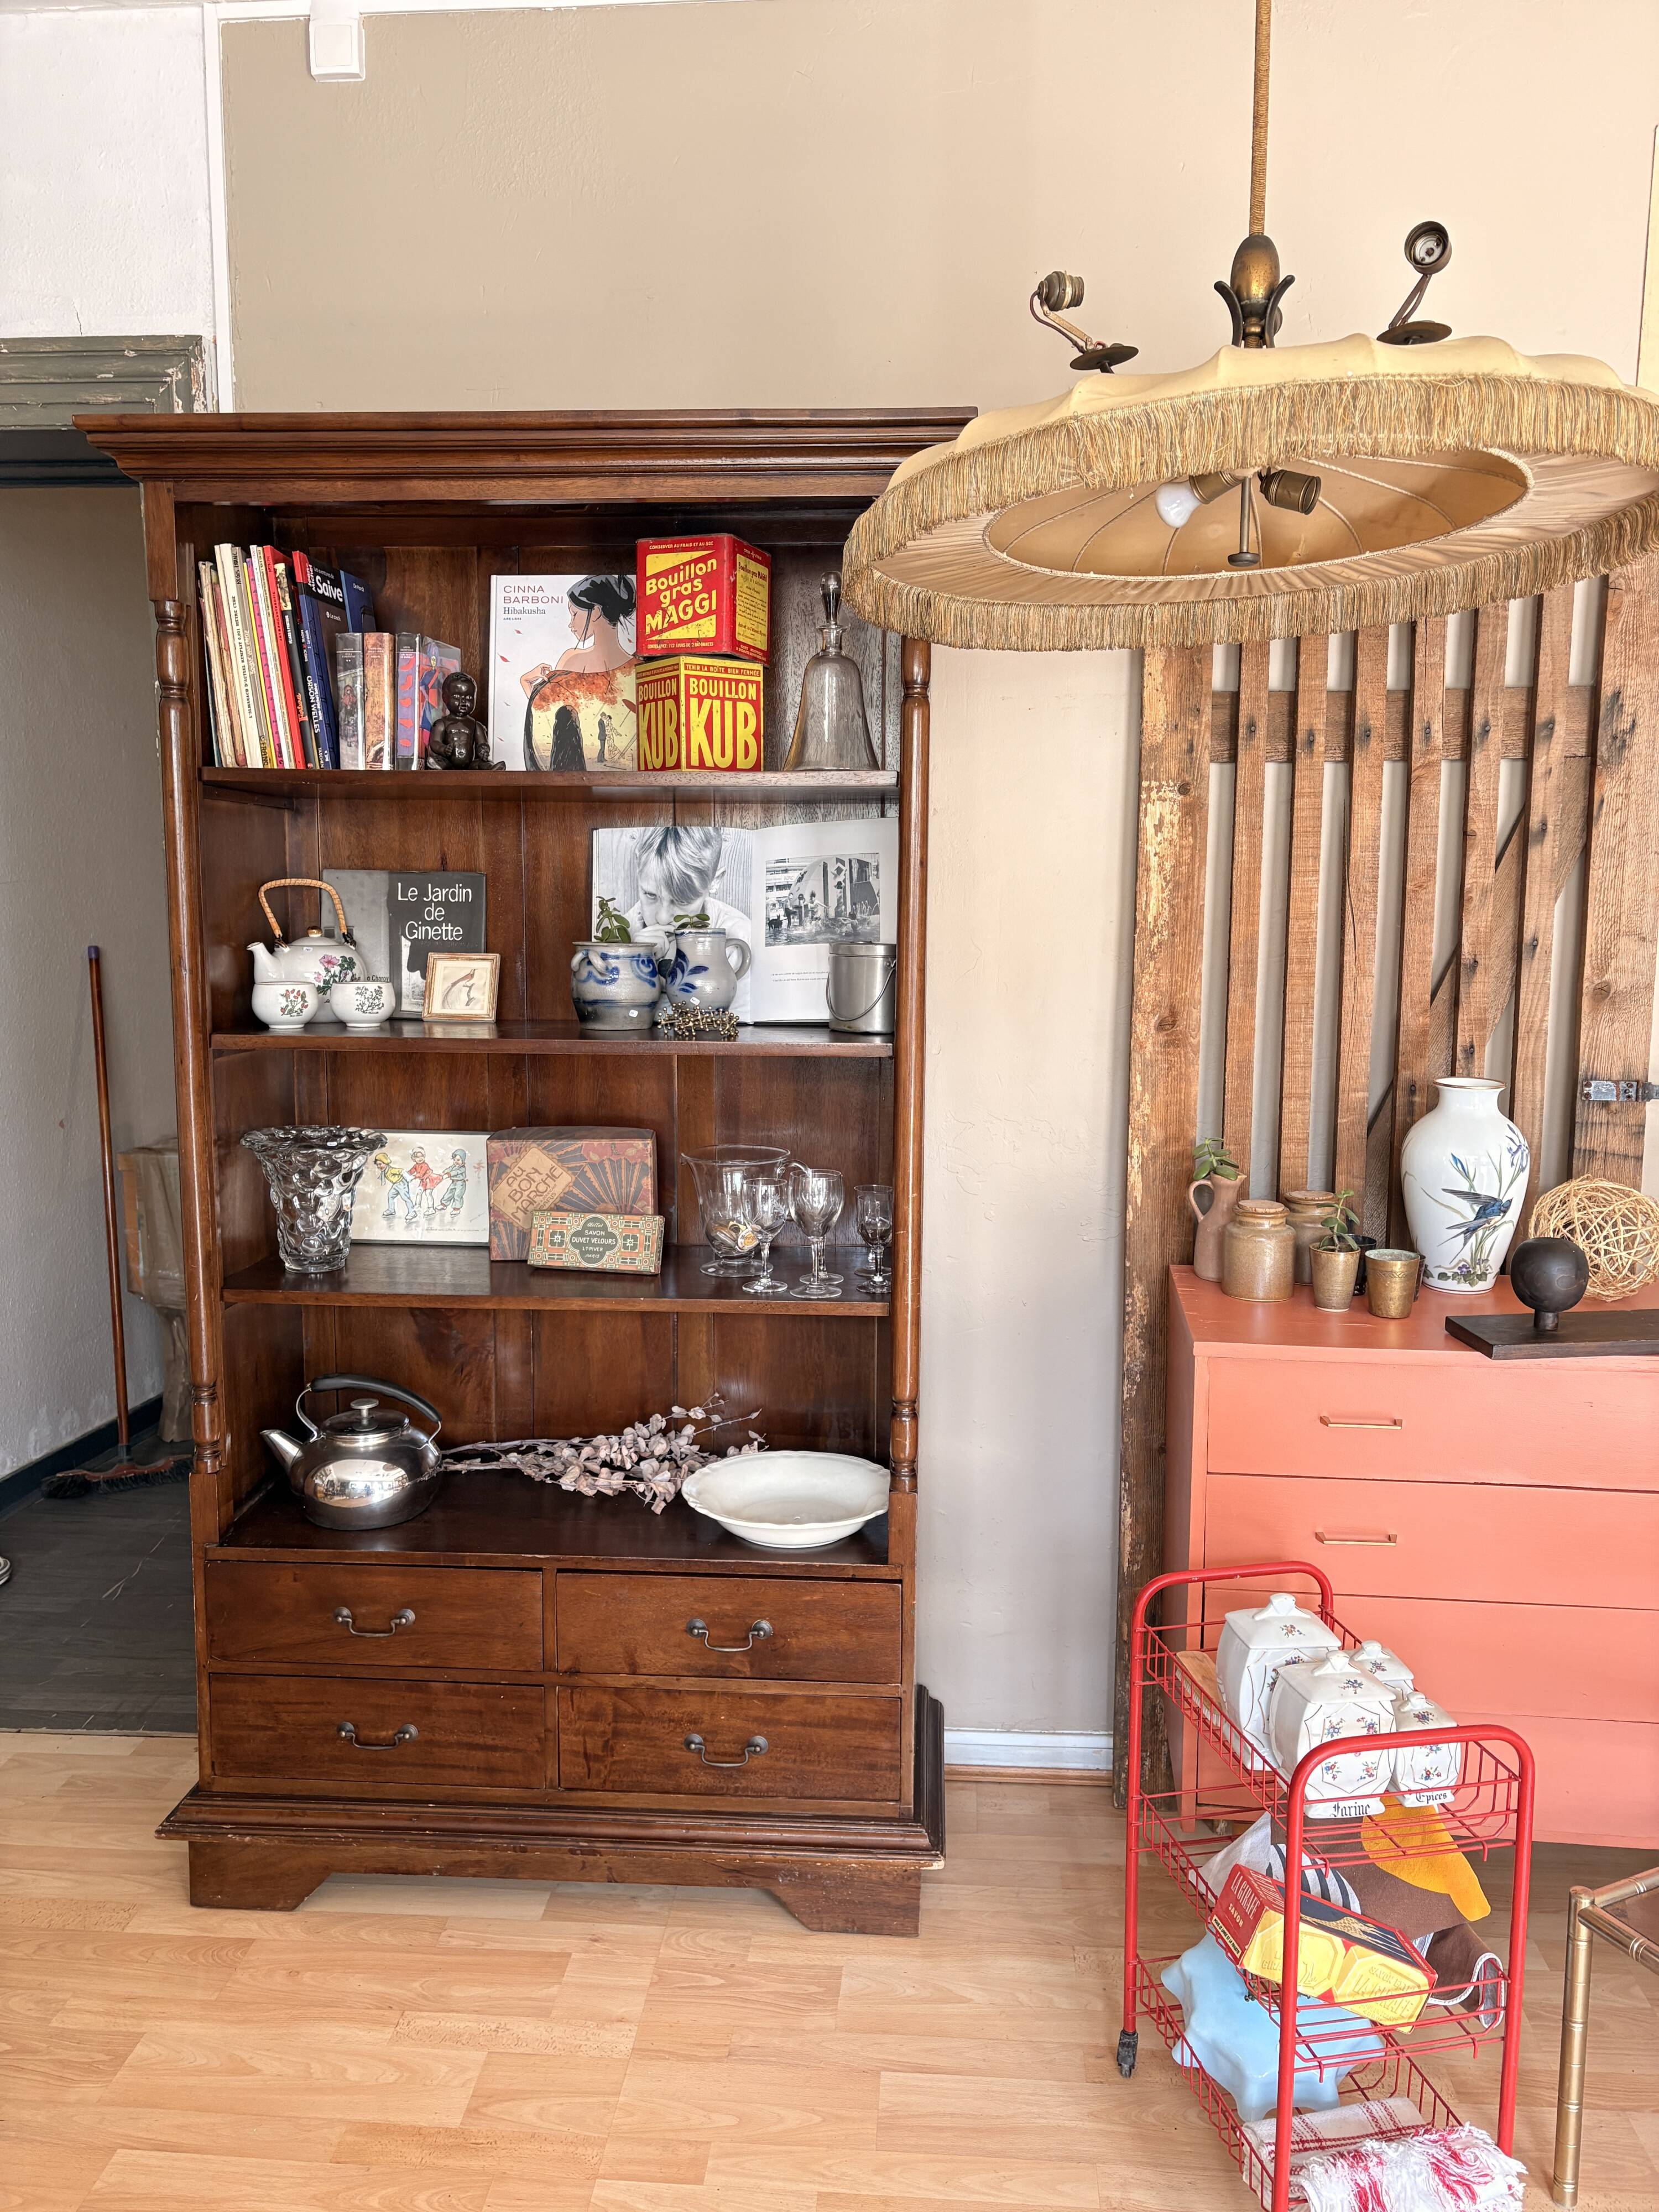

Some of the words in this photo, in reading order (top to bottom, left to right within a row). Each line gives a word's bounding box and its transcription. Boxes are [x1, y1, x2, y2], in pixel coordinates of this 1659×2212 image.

[316, 575, 343, 602] Saive
[646, 559, 717, 596] Bouillon
[660, 578, 702, 607] gras
[646, 589, 716, 635] MAGGI
[639, 678, 677, 702] BOUILLON
[690, 678, 757, 700] BOUILLON
[306, 676, 315, 702] ORSON
[311, 703, 320, 733] WELLES
[639, 698, 678, 770] KUB
[690, 697, 757, 769] KUB
[398, 883, 418, 901] Le
[424, 883, 472, 902] Jardin
[425, 902, 445, 921] de
[405, 921, 463, 941] Ginette
[507, 1166, 526, 1187] AU
[508, 1167, 542, 1203] BON
[511, 1164, 563, 1222] MARCHÉ
[539, 1193, 556, 1210] PARIS
[1330, 1802, 1370, 1817] Farine
[1231, 1871, 1243, 1895] LA
[1237, 1880, 1260, 1920] GIRAFE
[1228, 1903, 1244, 1927] SAVON
